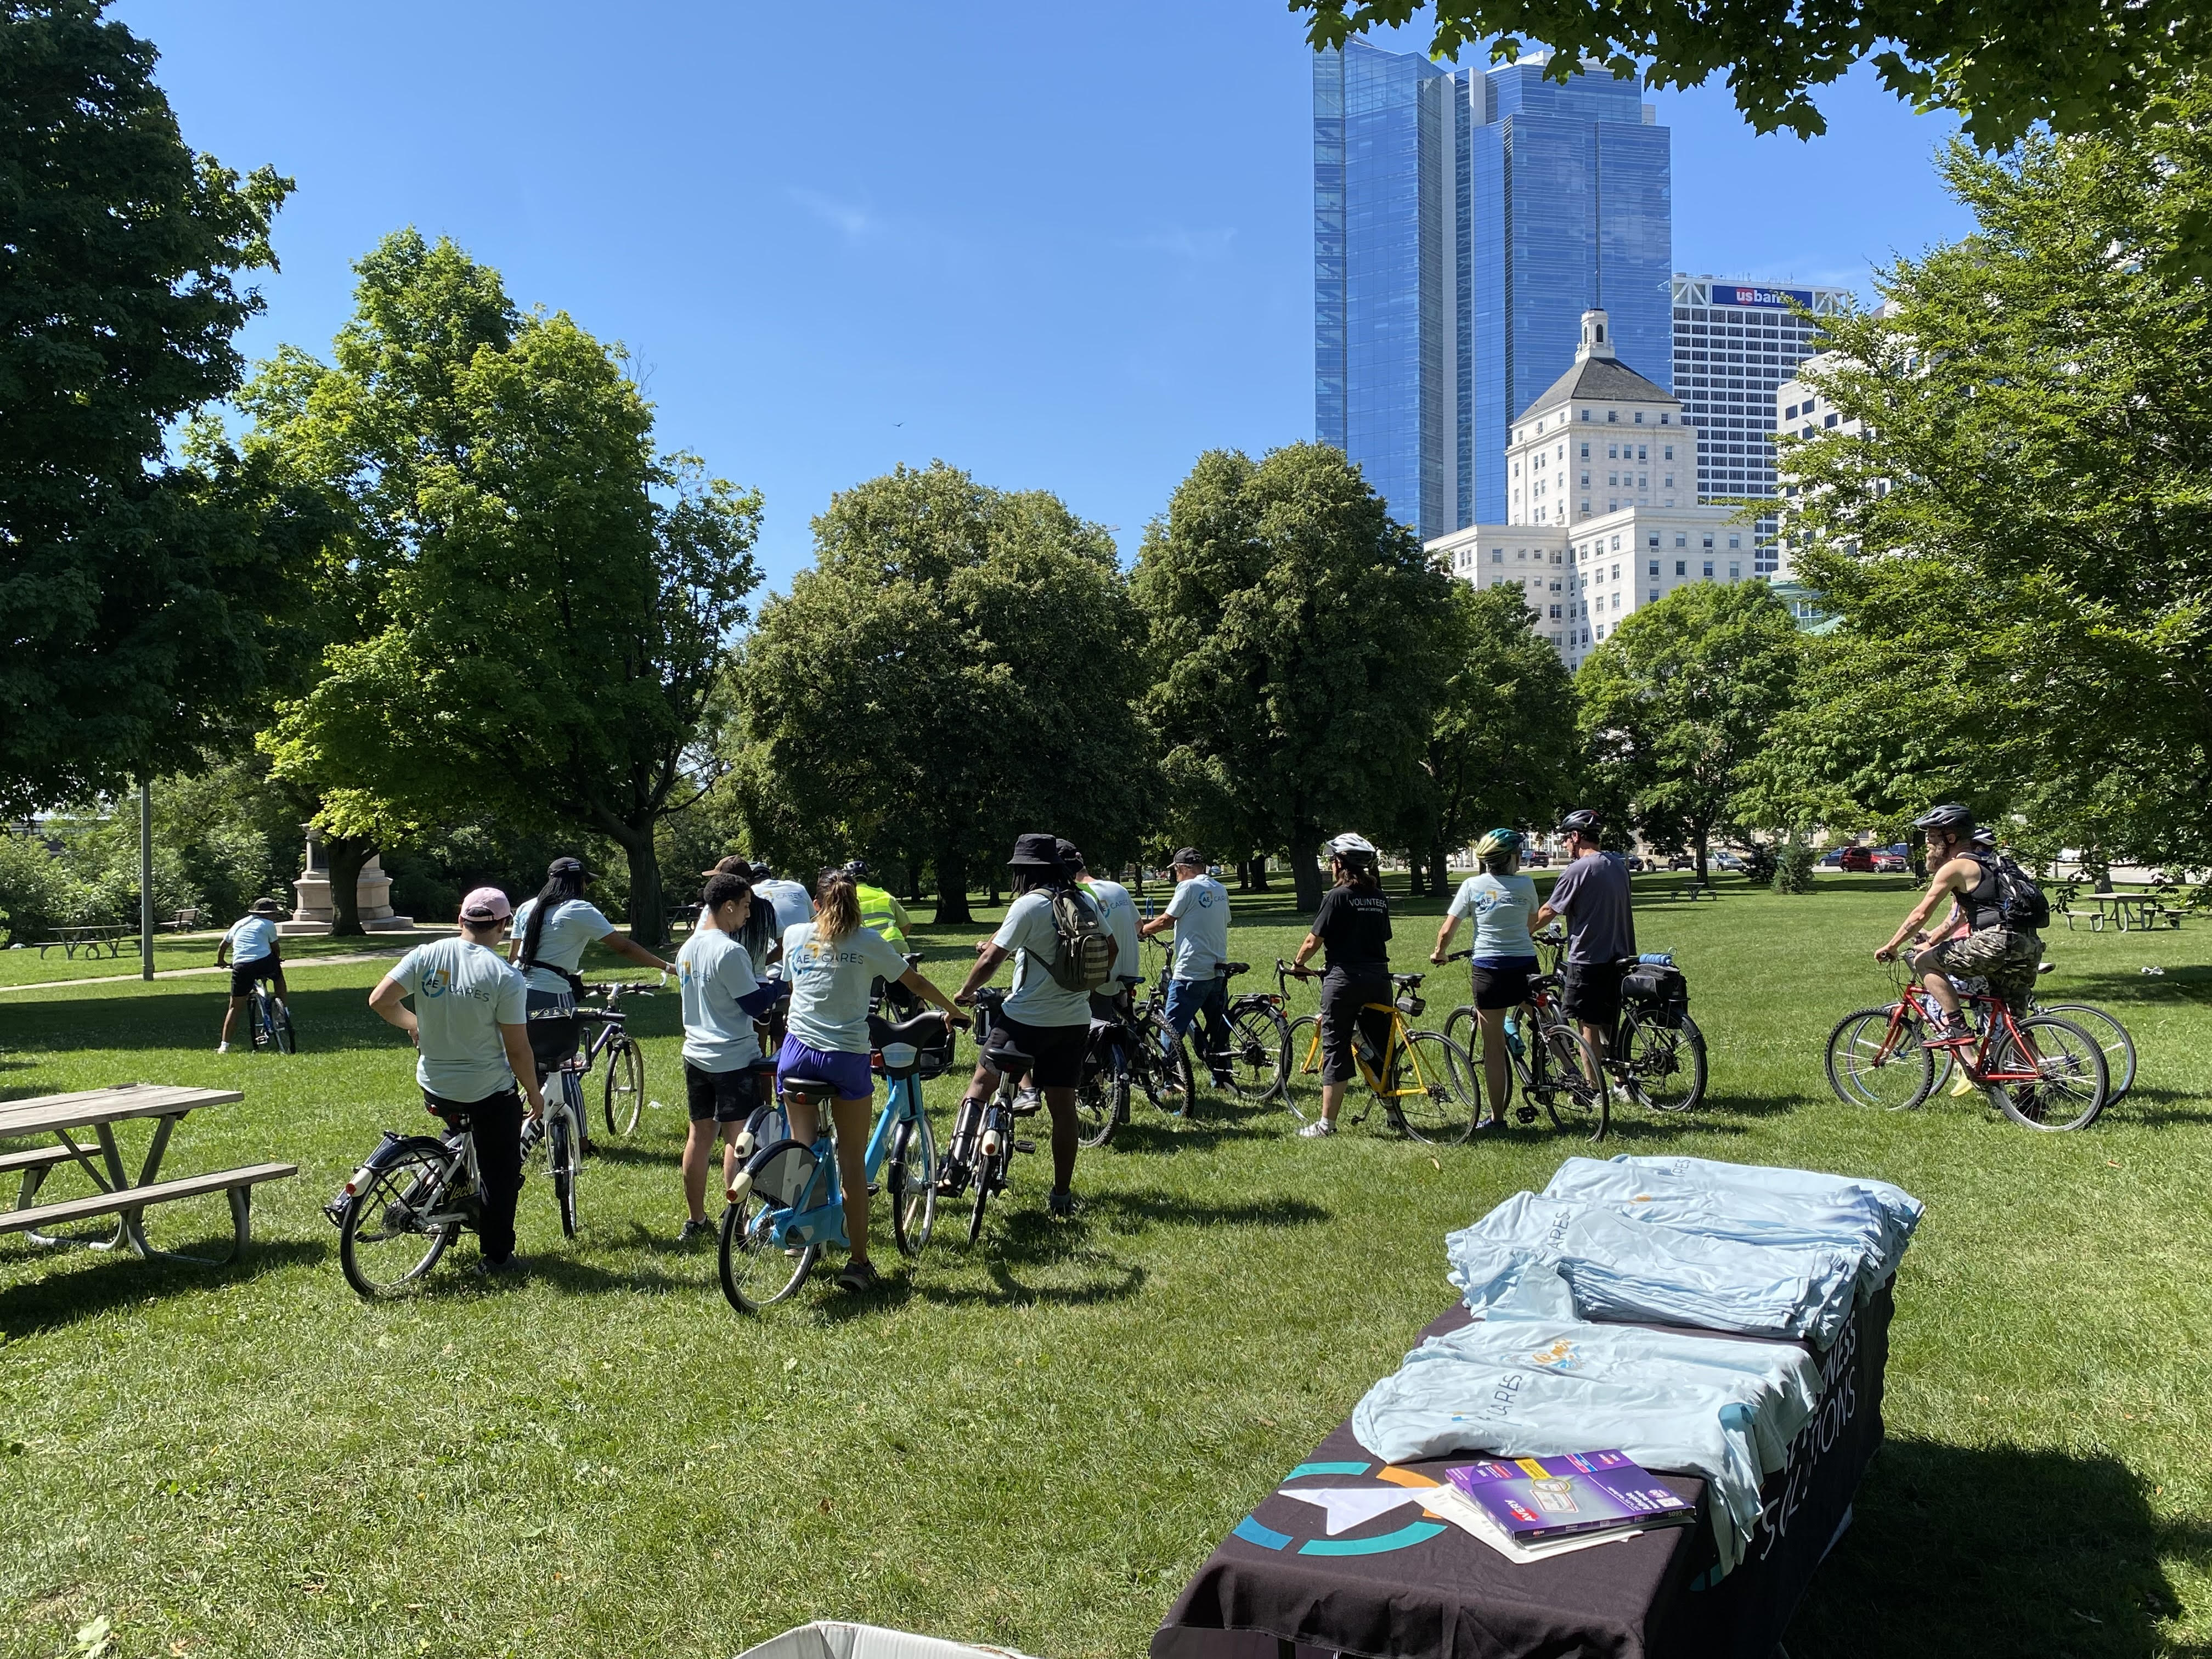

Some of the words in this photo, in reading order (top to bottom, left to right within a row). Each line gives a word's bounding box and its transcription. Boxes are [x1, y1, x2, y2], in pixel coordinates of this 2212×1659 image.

[1736, 290, 1784, 303] usban
[796, 954, 810, 964] AE
[821, 952, 865, 964] CARES
[425, 978, 439, 989] AE
[449, 983, 490, 1002] CARES
[1547, 1211, 1571, 1250] ARES
[1504, 1499, 1536, 1522] AVERY
[1668, 1510, 1683, 1518] 5095
